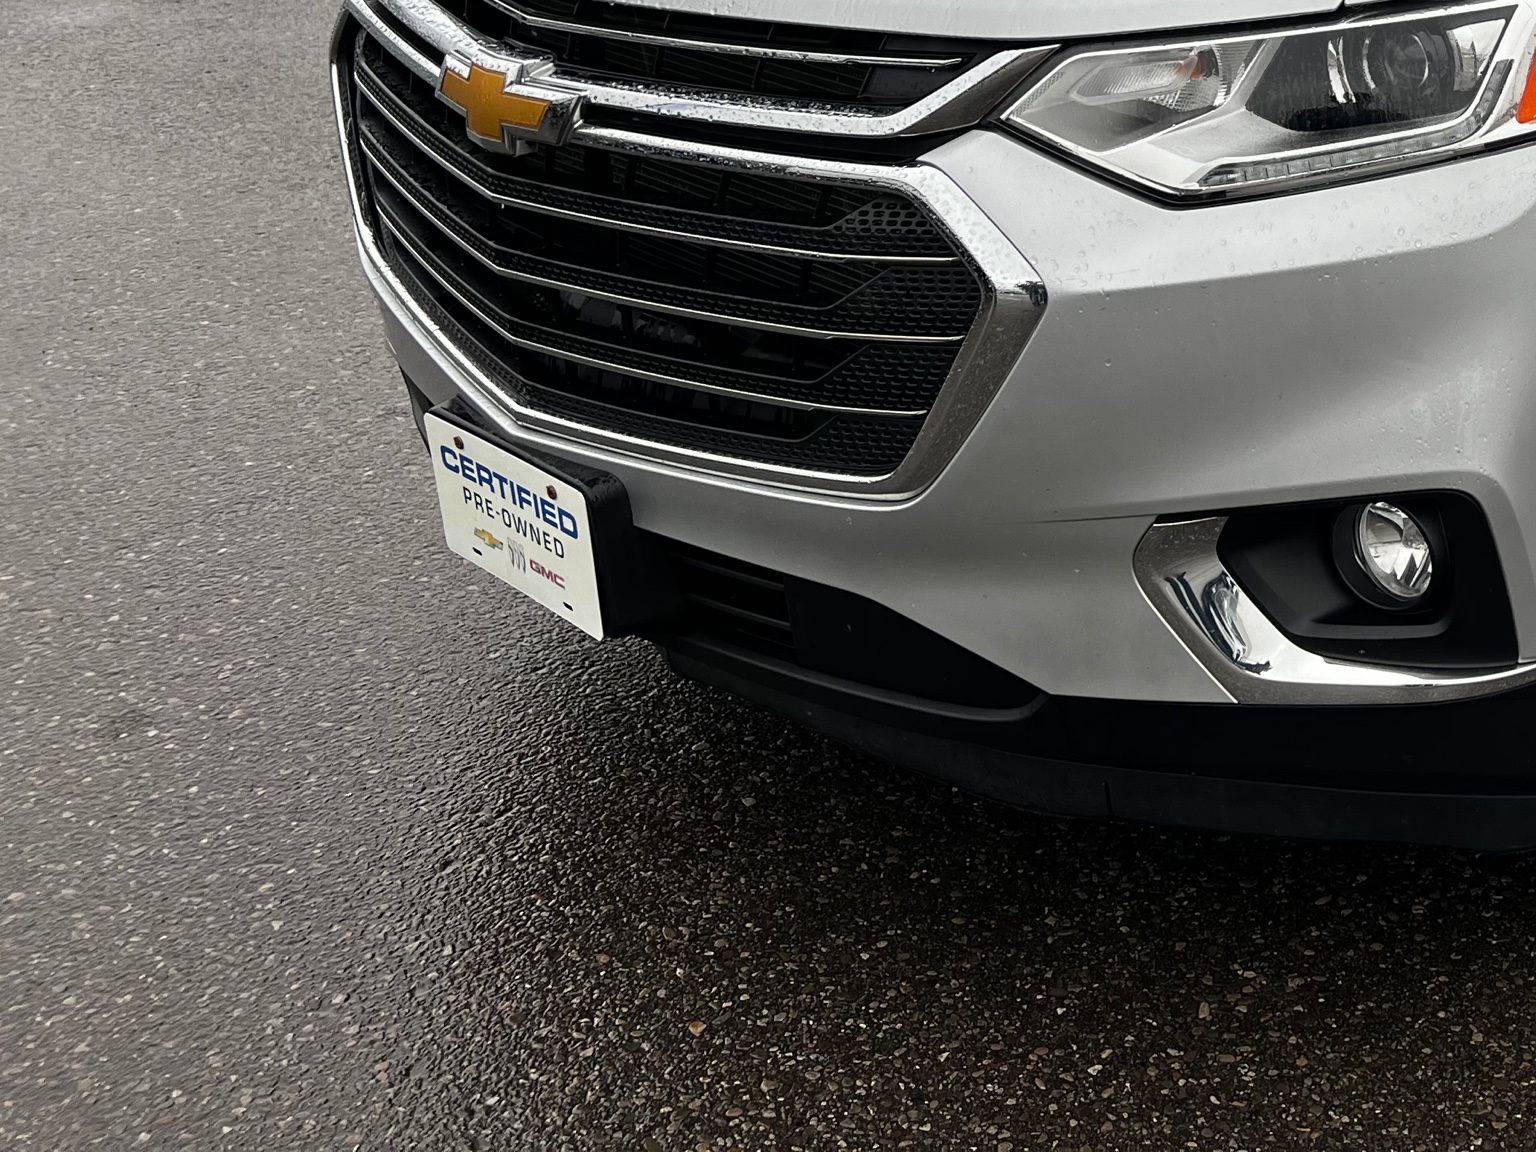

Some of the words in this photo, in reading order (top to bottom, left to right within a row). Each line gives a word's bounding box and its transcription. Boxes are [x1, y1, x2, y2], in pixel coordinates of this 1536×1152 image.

[440, 445, 579, 540] CERTIFIED
[462, 486, 565, 559] PRE-OWNED
[529, 559, 566, 590] GMC
